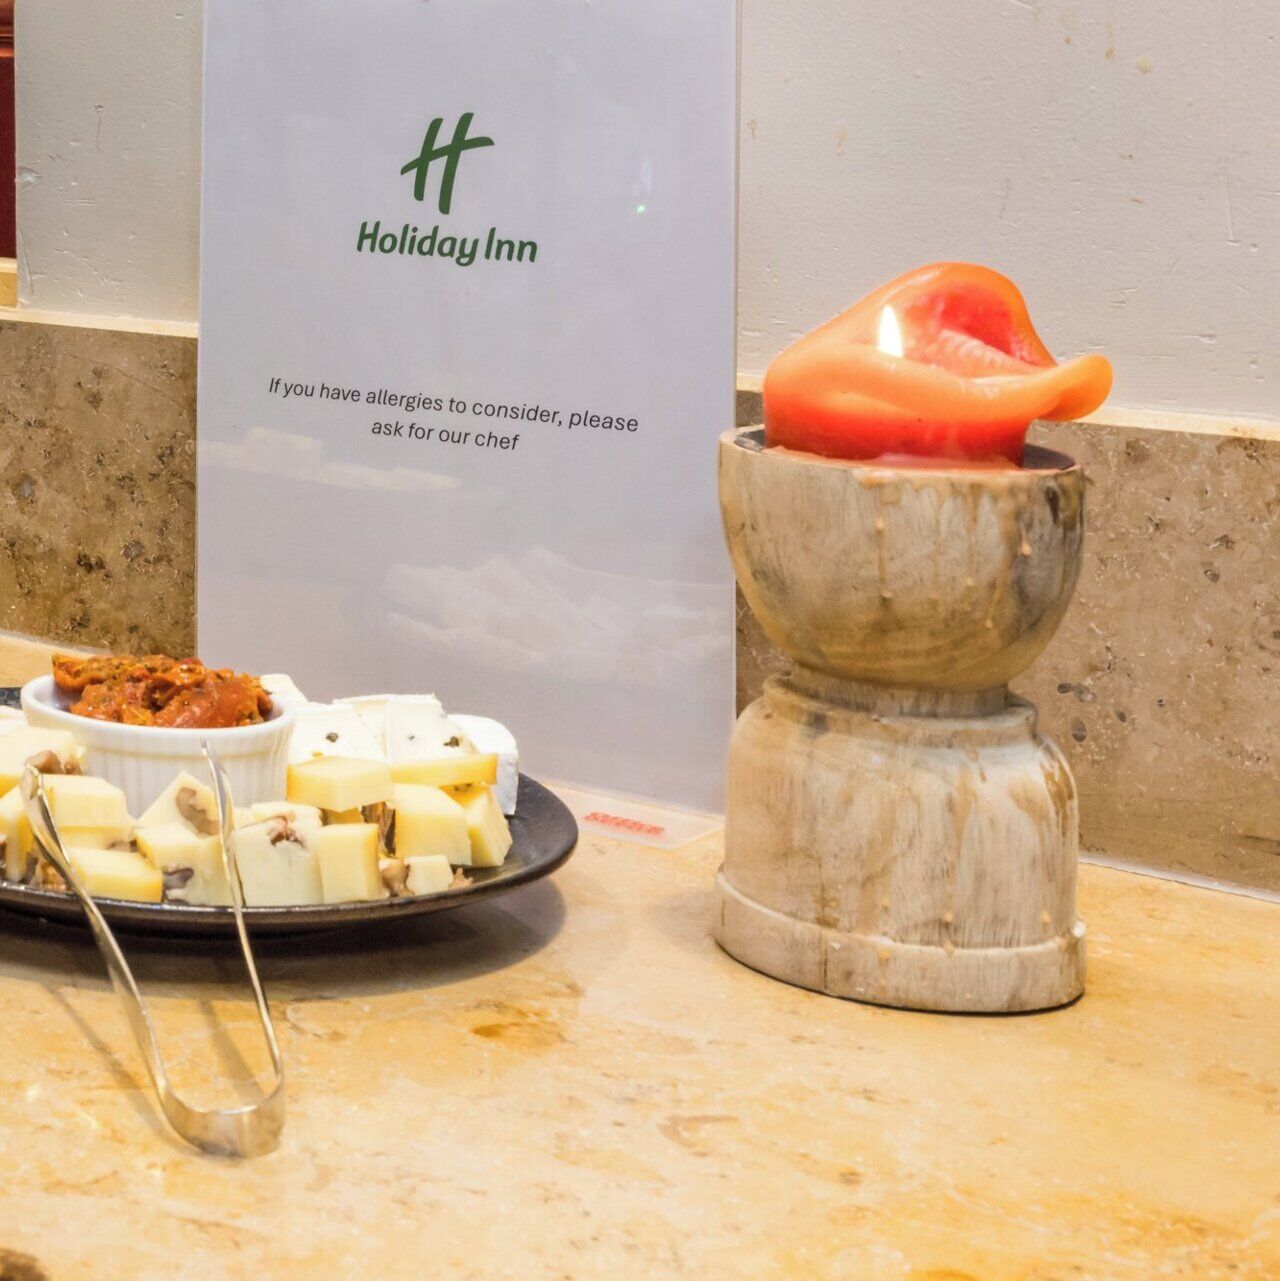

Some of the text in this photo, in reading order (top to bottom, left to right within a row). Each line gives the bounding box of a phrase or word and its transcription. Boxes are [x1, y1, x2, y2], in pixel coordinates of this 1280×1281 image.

[356, 221, 538, 267] Holiday Inn
[269, 377, 639, 433] If you have allergies to consider, please
[371, 418, 520, 451] ask for our chef
